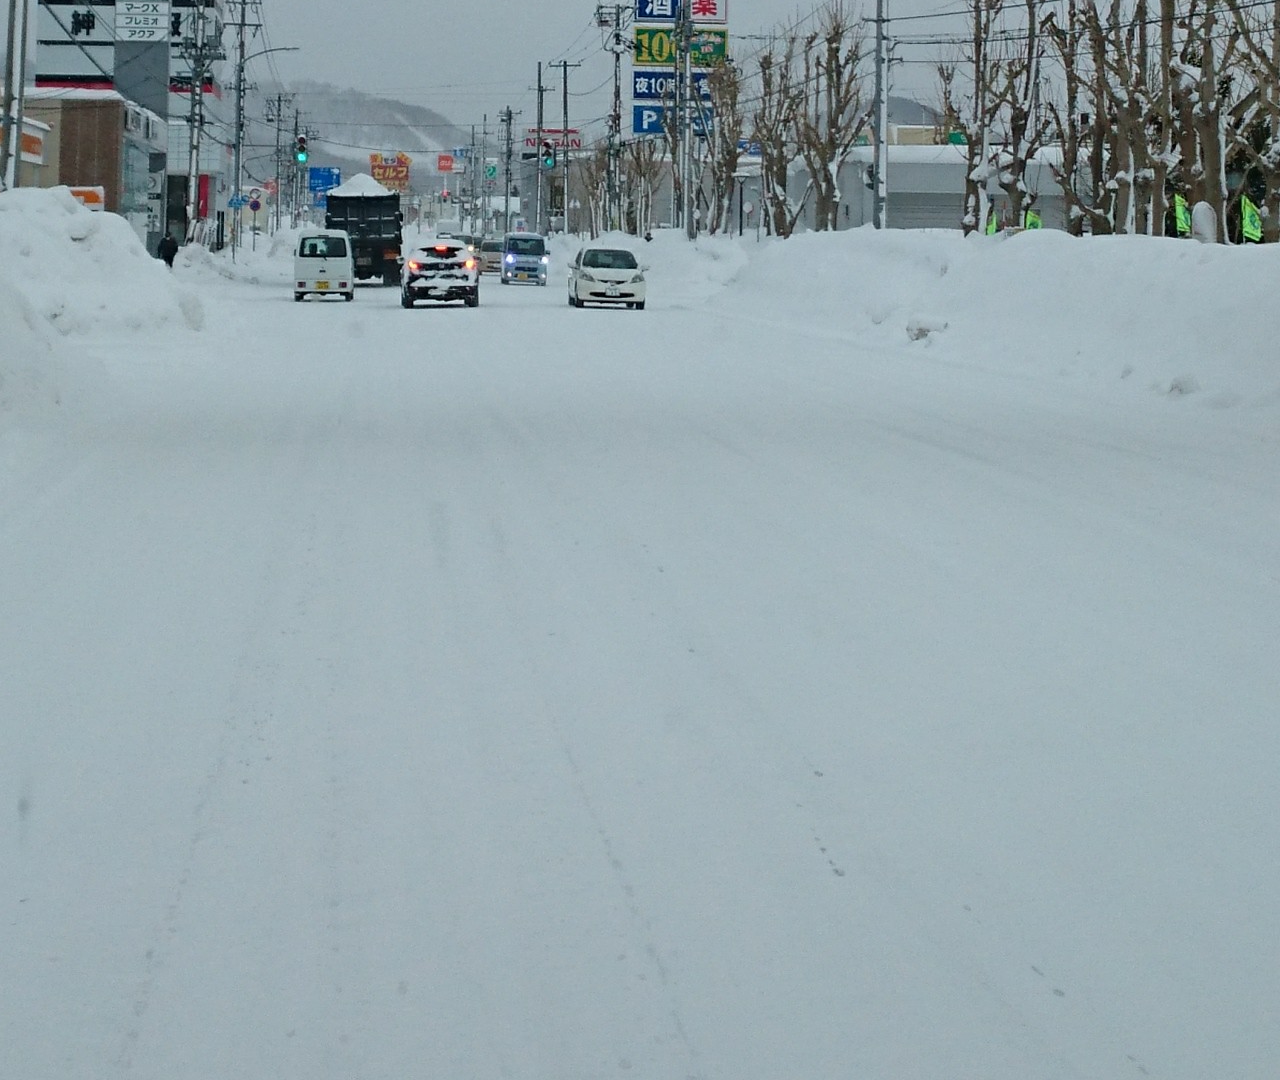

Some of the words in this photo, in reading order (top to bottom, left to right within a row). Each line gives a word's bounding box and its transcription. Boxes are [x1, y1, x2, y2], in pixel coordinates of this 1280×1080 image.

[127, 30, 155, 38] アクア
[642, 110, 658, 129] P
